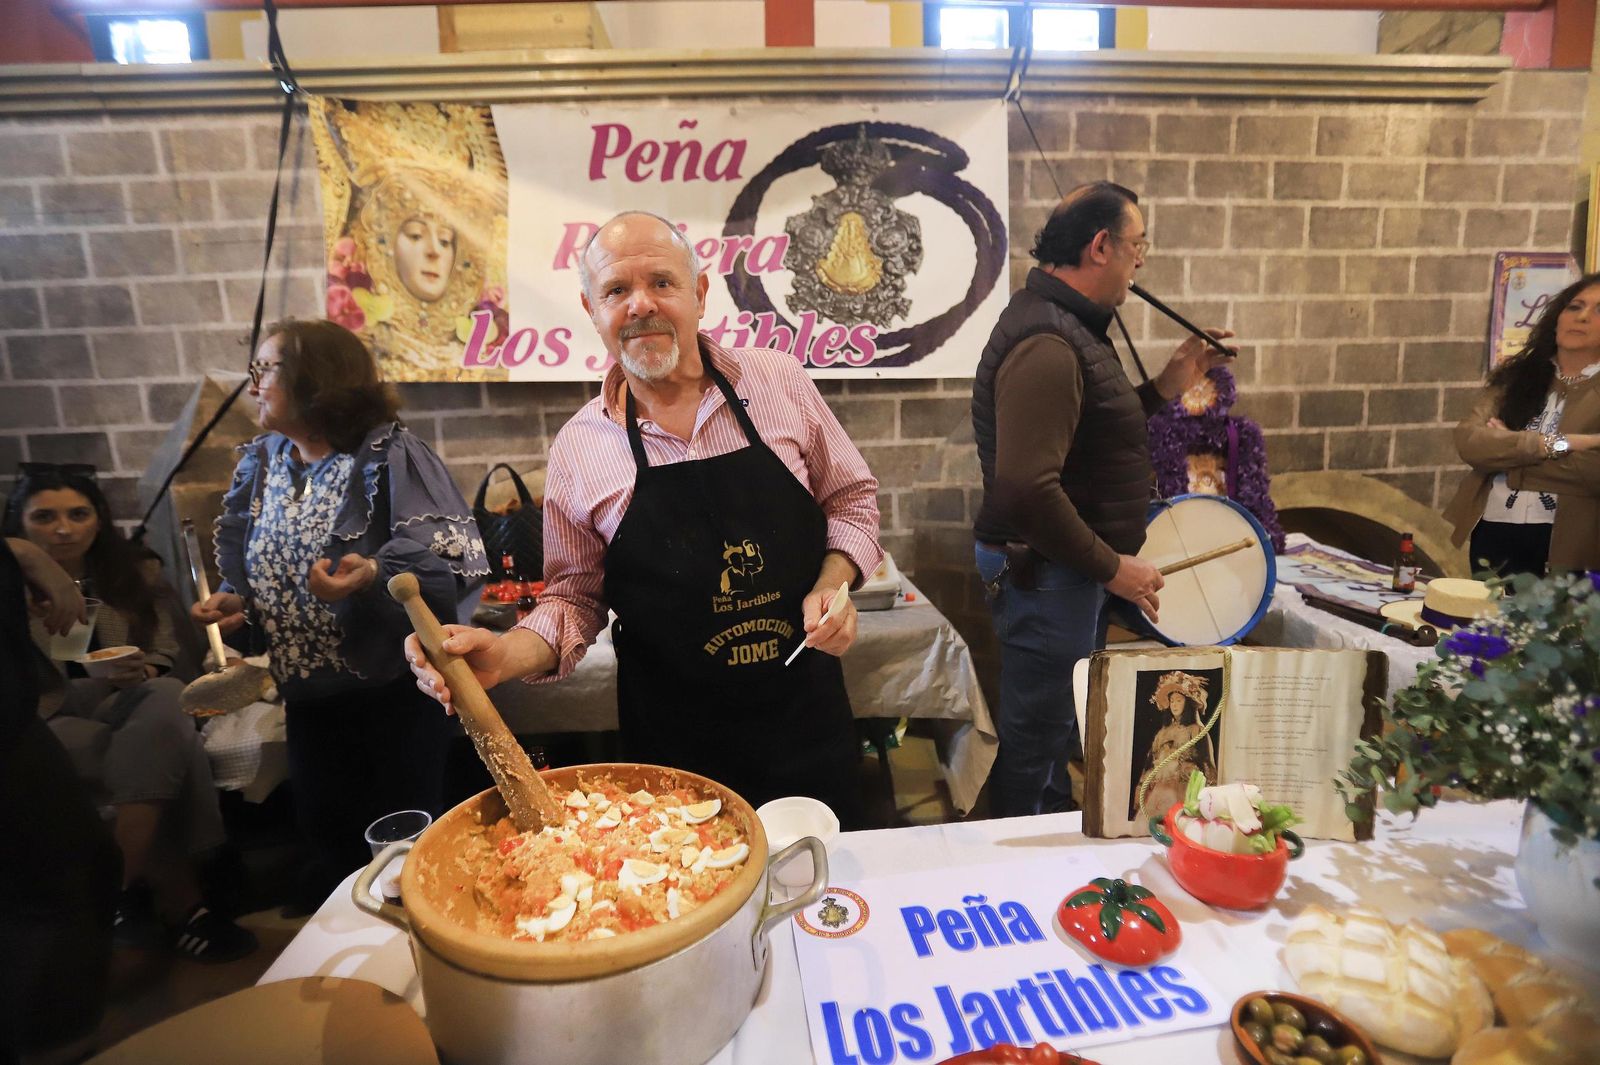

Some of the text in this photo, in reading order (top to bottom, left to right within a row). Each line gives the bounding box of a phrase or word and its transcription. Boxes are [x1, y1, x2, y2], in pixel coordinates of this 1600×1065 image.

[589, 120, 747, 182] Peña
[553, 222, 790, 275] Rera
[464, 312, 877, 371] Los tibles
[713, 591, 781, 613] Los Jartibles
[728, 638, 779, 666] JOME
[900, 894, 1047, 958] Peña
[820, 963, 1209, 1065] Los Jartibles
